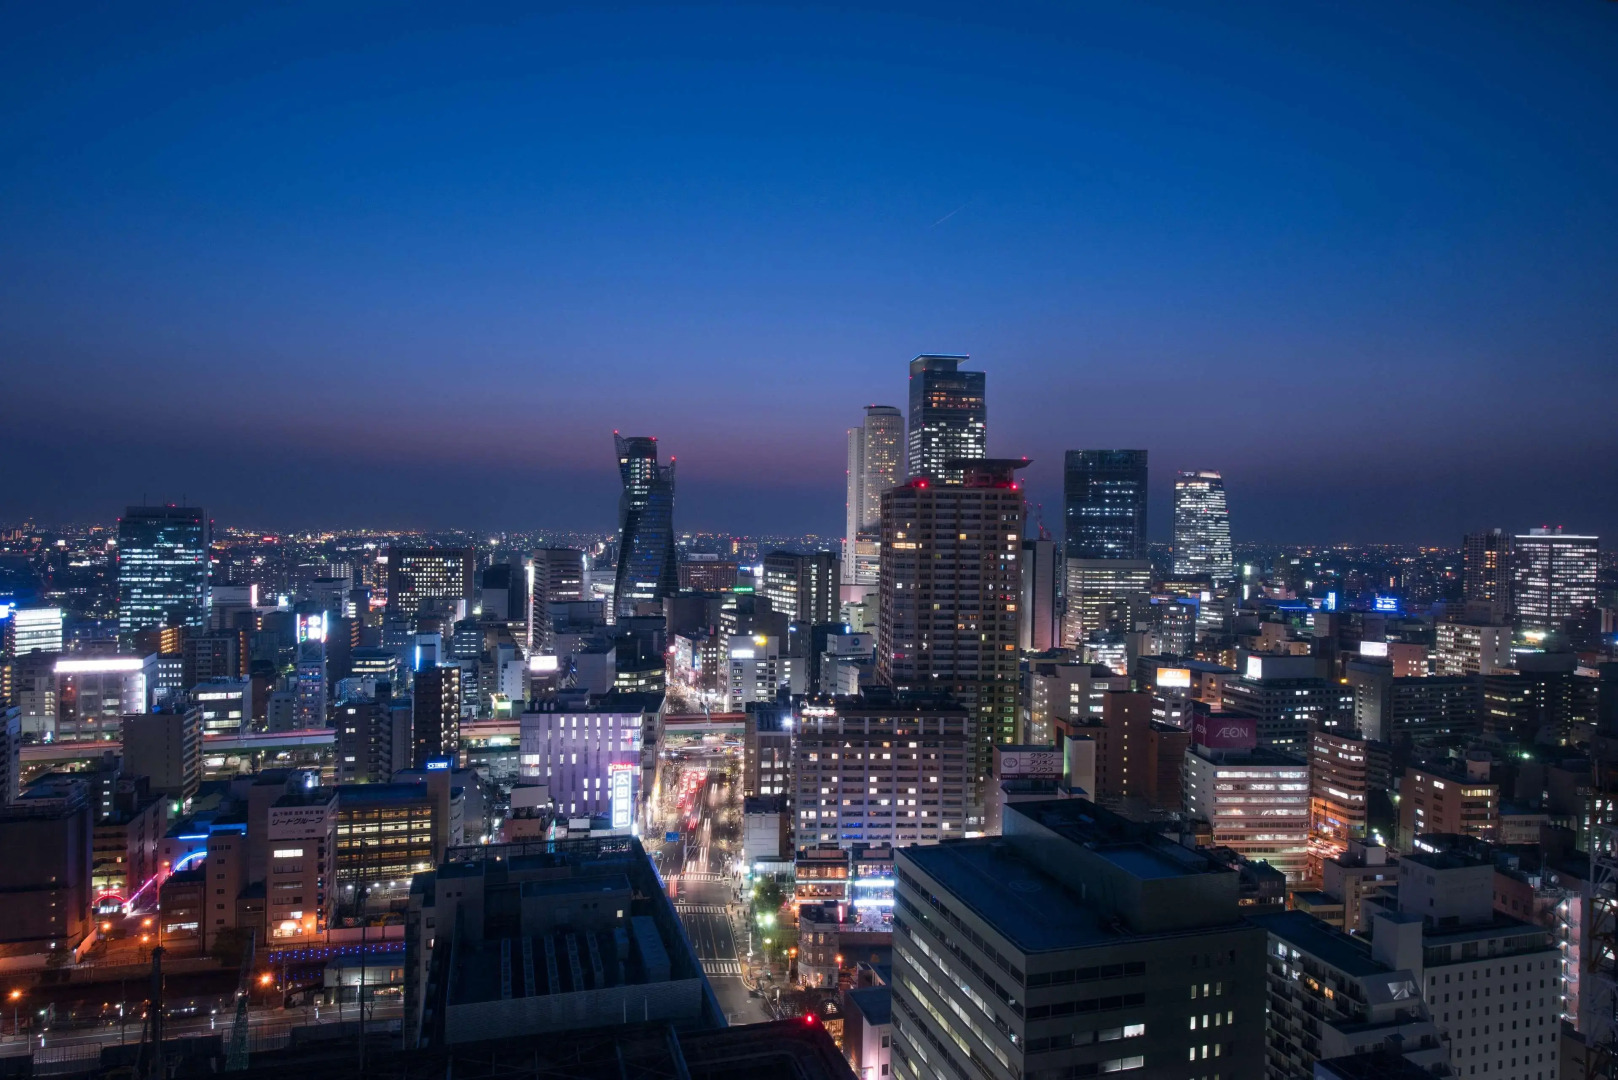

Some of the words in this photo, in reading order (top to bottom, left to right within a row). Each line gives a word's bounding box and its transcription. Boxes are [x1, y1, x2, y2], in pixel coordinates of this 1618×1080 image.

[272, 816, 324, 826] リードグループ
